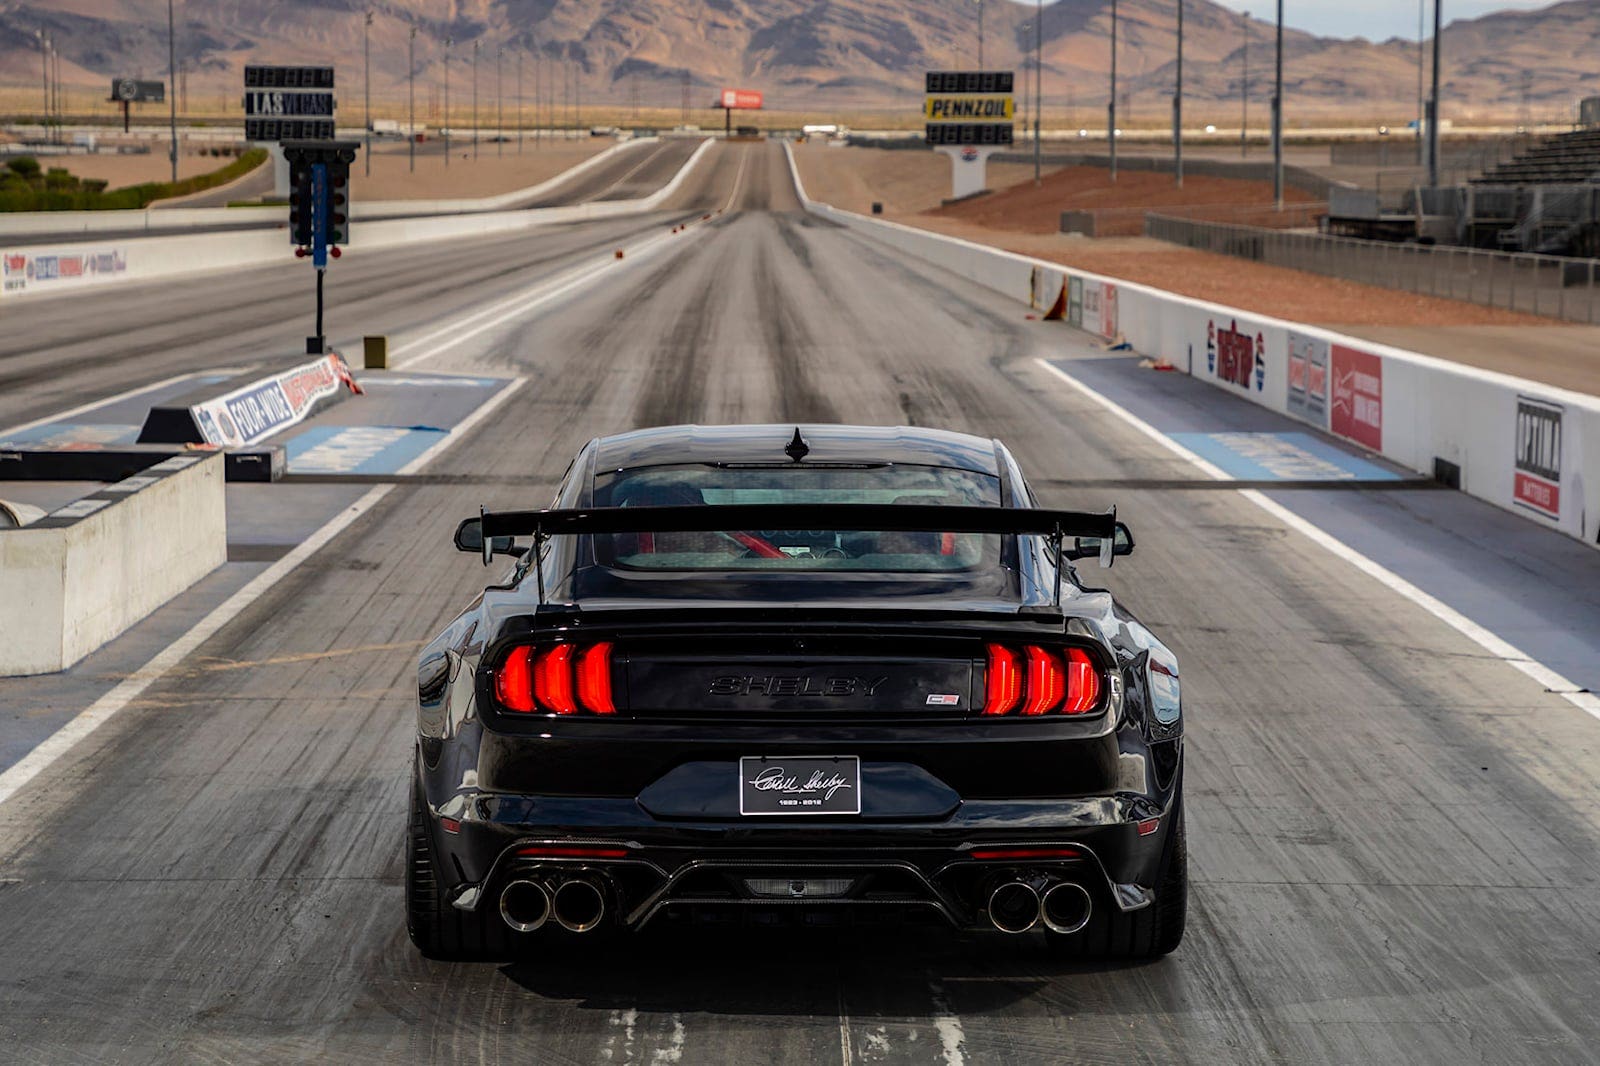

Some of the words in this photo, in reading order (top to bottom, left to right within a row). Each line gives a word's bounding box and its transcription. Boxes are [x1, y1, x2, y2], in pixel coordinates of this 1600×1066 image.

[252, 92, 283, 114] LAS
[932, 98, 1006, 117] PENNZOIL
[230, 384, 291, 438] FOUR-WIDE
[708, 675, 888, 697] SHELBY
